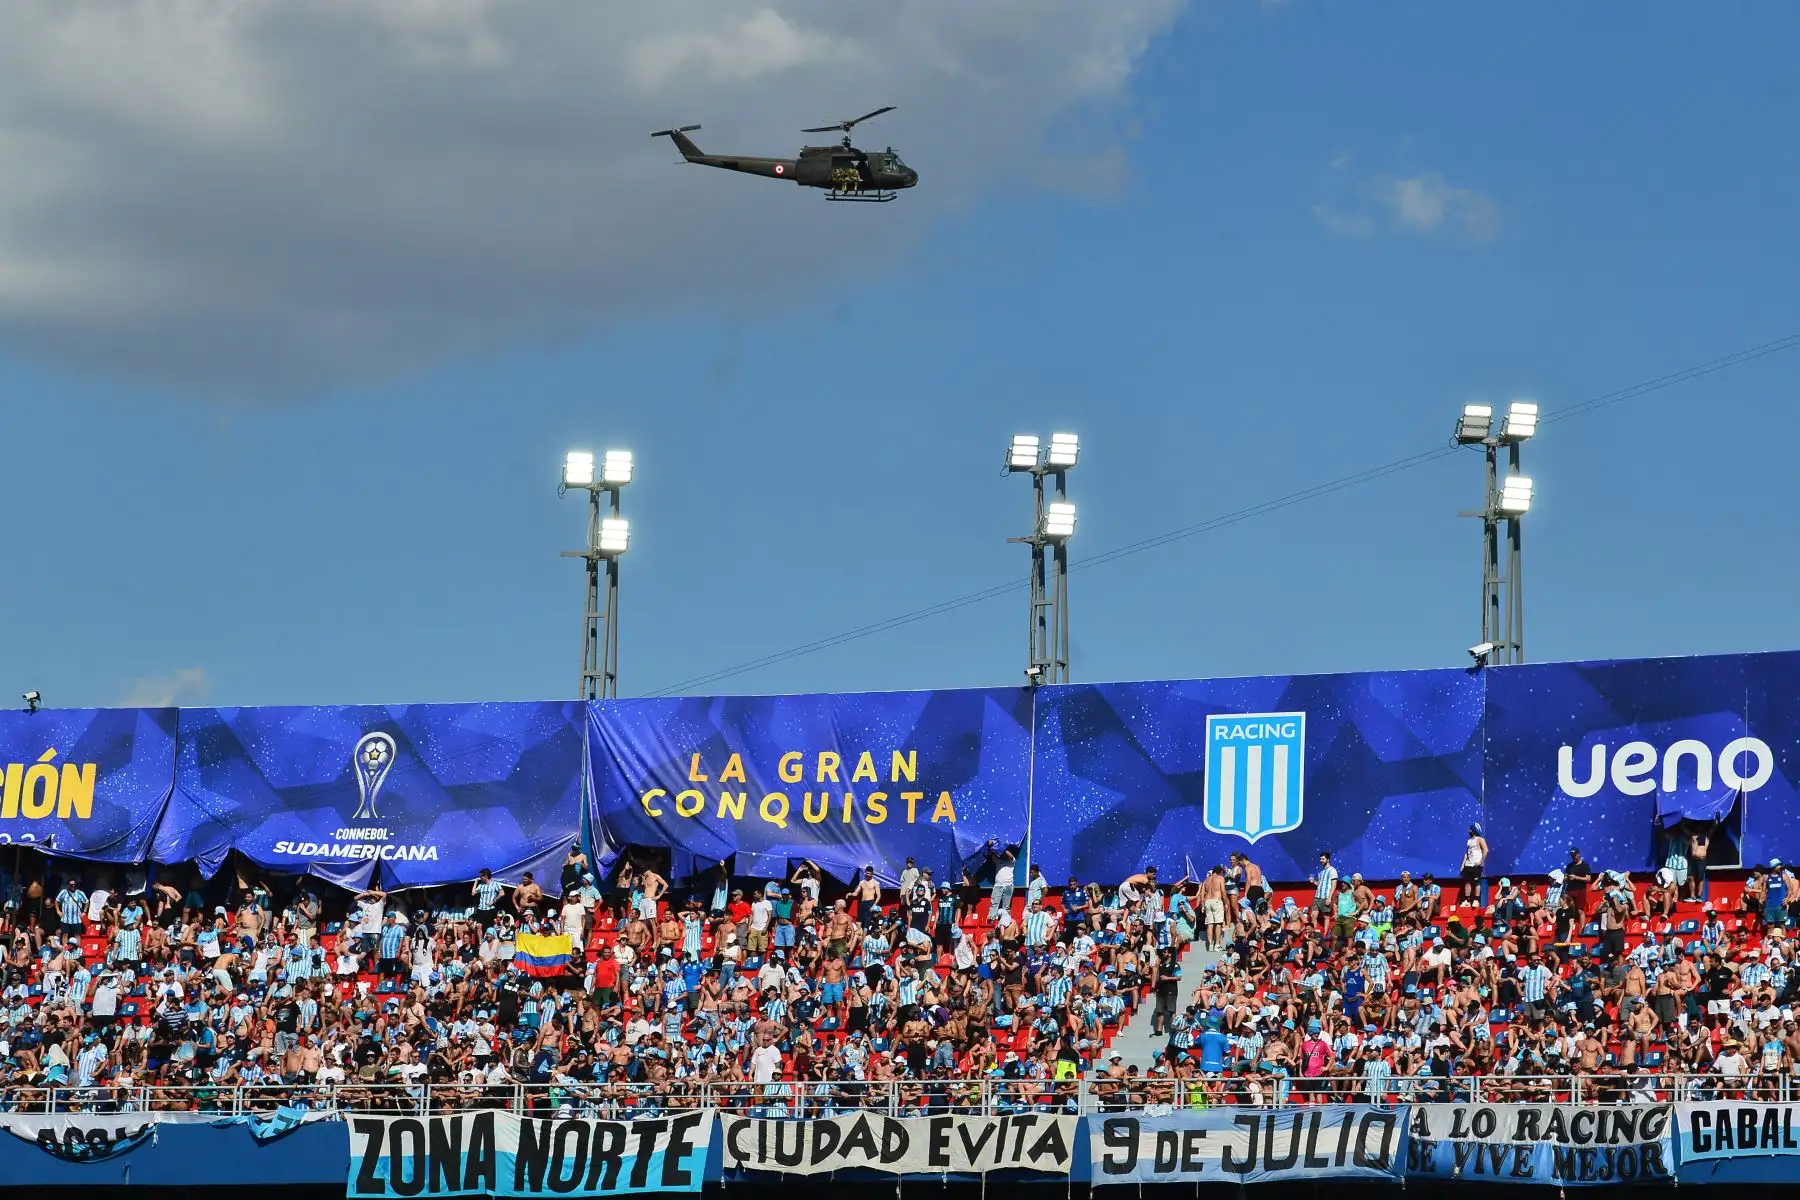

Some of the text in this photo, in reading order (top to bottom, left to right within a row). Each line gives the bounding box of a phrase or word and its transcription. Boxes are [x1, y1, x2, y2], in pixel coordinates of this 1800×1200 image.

[1215, 722, 1296, 740] RACING
[0, 747, 97, 819] IÓN
[688, 750, 917, 783] LA GRAN
[1558, 737, 1774, 798] ueno
[641, 788, 957, 829] CONQUISTA
[273, 841, 439, 861] SUDAMERICANA
[727, 1113, 1070, 1167] CIUDAD EVITA
[1103, 1111, 1397, 1174] 9 DE JULIO
[1410, 1104, 1672, 1144] A LO RACING
[1690, 1108, 1798, 1153] CABAL
[353, 1111, 703, 1197] ZONA NORTE
[1453, 1141, 1534, 1177] VIVE
[1552, 1142, 1668, 1181] MEJOR
